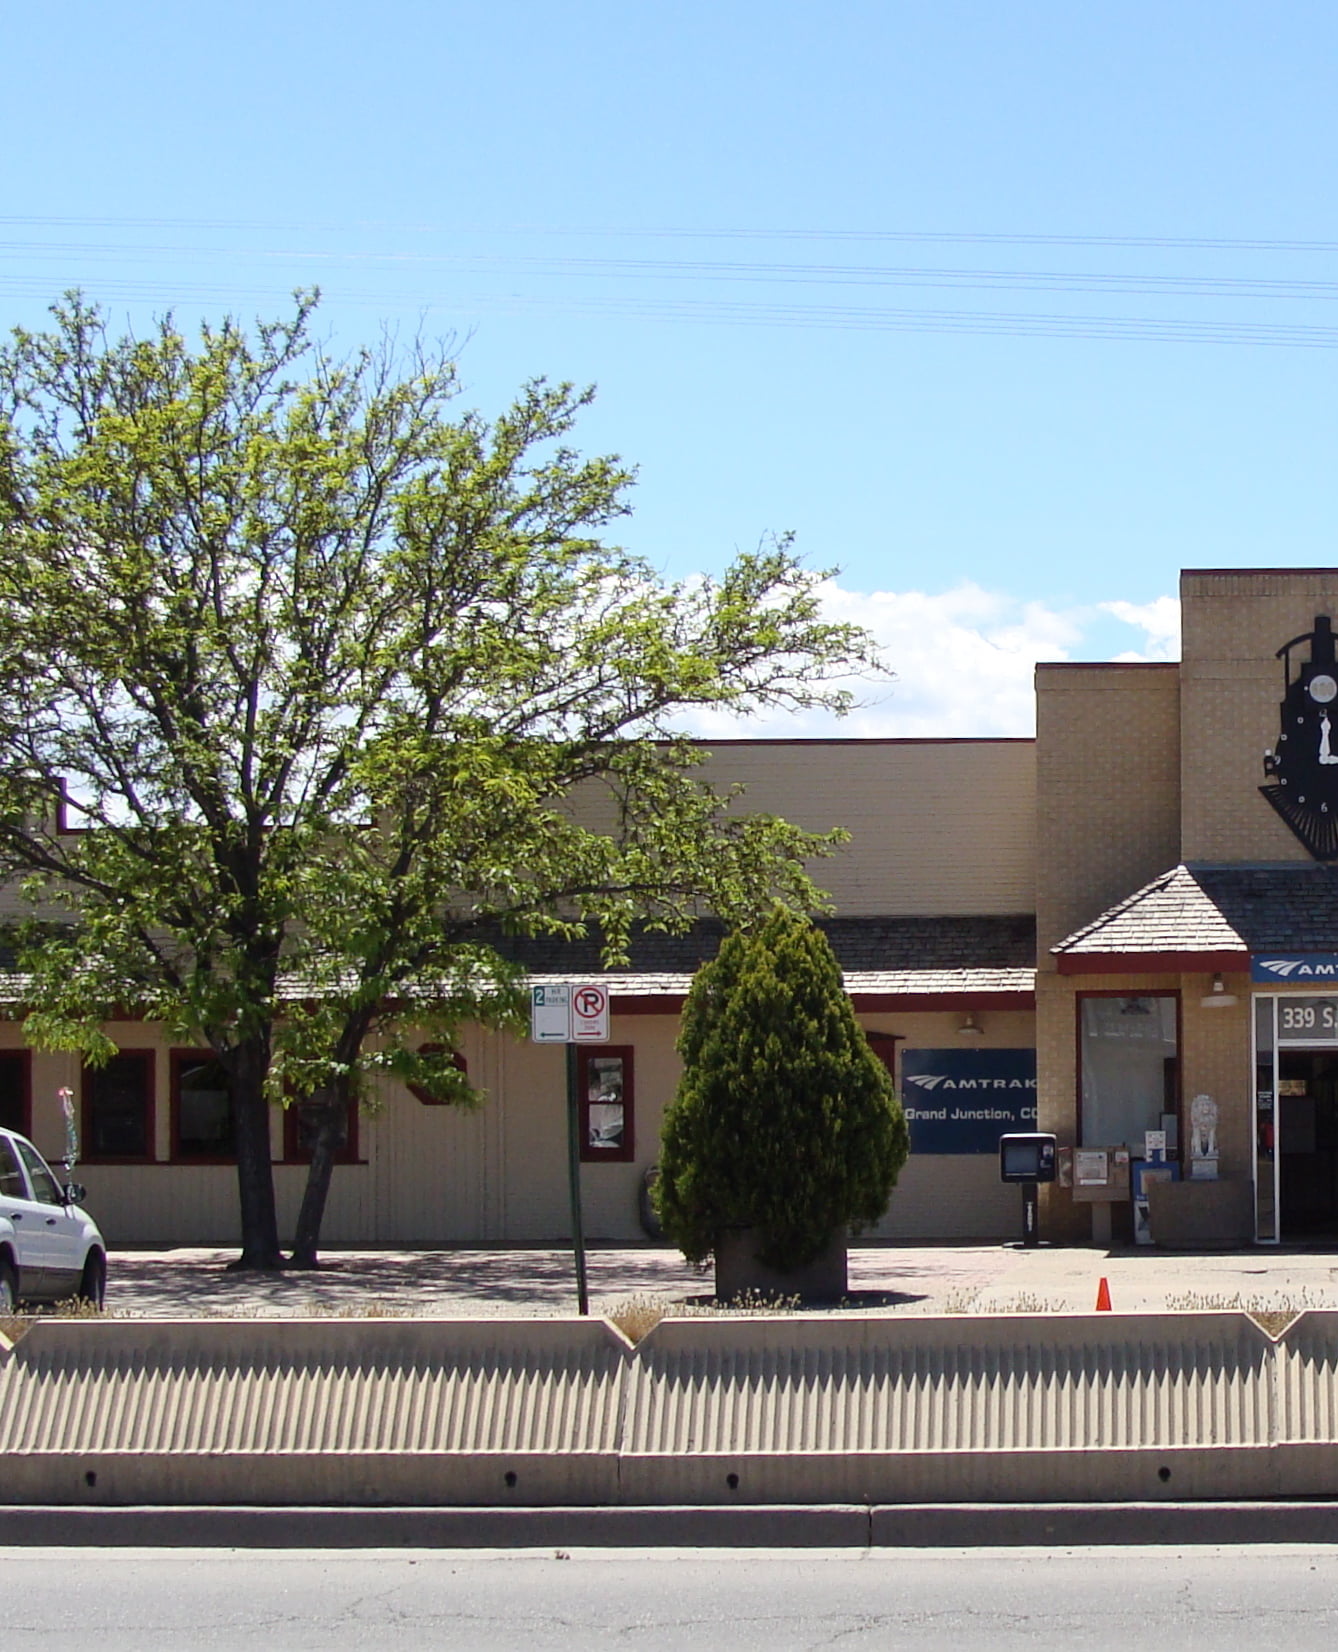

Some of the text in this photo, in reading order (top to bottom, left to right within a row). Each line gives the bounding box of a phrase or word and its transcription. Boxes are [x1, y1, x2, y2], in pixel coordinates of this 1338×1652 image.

[535, 989, 545, 1004] 2
[1283, 1007, 1316, 1028] 339
[942, 1079, 1037, 1089] AMTRAK
[904, 1108, 947, 1120] Grand
[950, 1108, 1015, 1121] Junction,
